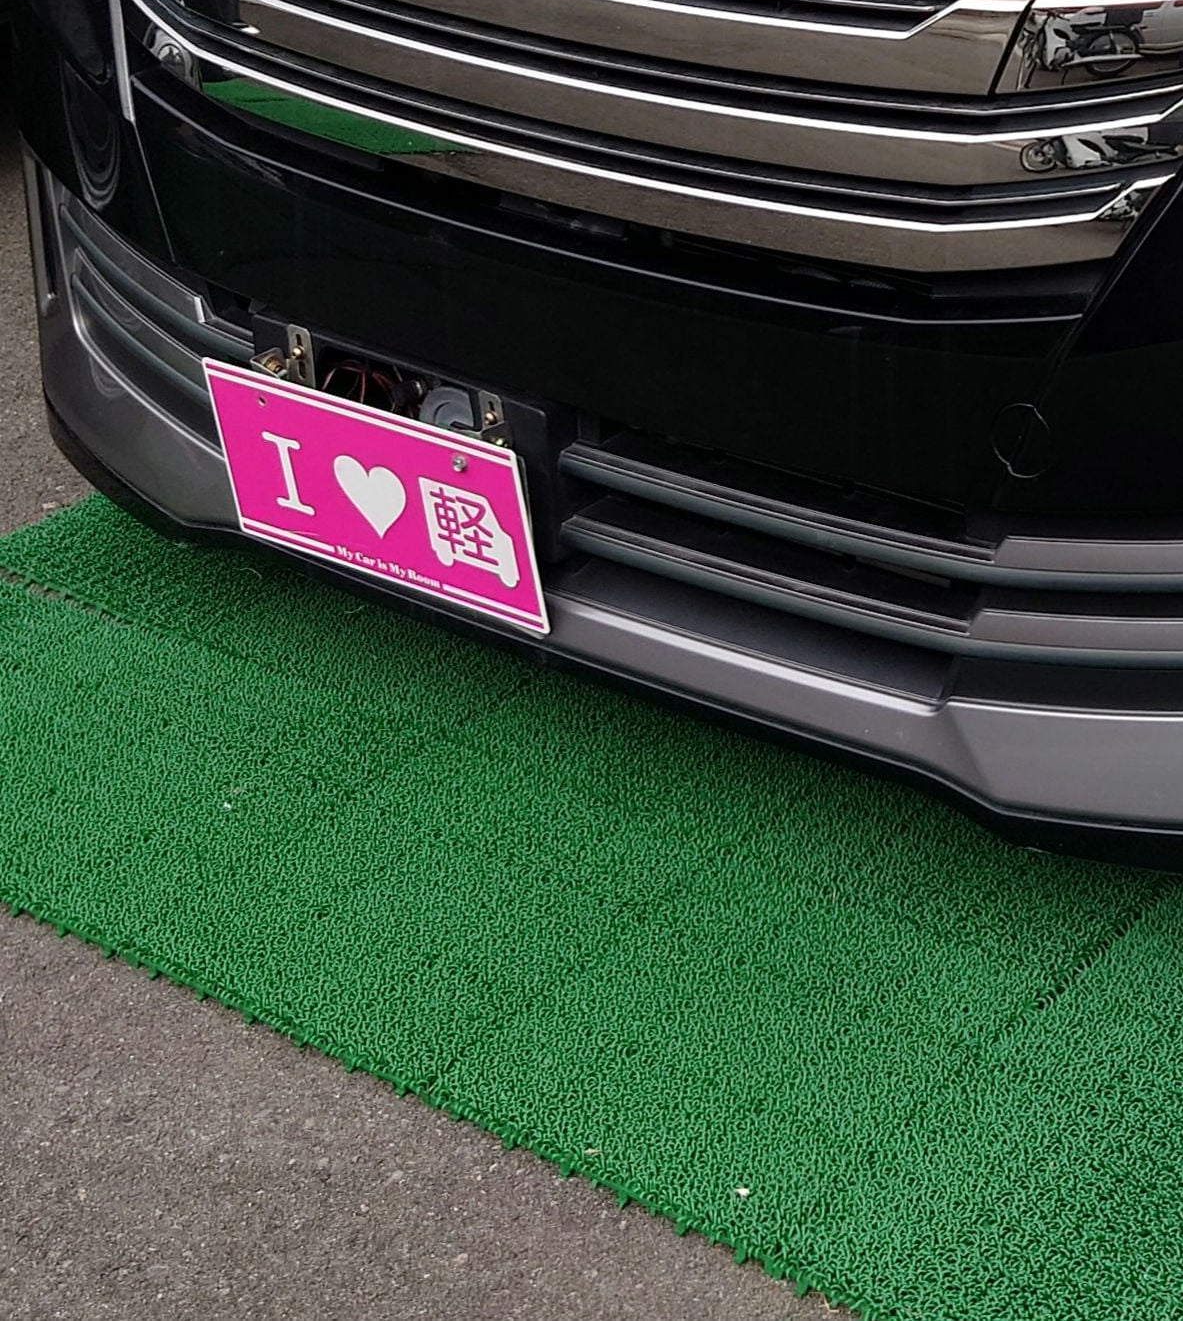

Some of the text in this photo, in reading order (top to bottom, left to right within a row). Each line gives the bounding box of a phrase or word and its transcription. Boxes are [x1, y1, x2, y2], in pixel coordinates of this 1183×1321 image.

[261, 431, 500, 566] I 軽
[336, 545, 354, 561] My
[355, 552, 377, 567] Car
[388, 563, 407, 578] My
[407, 569, 441, 589] Room
